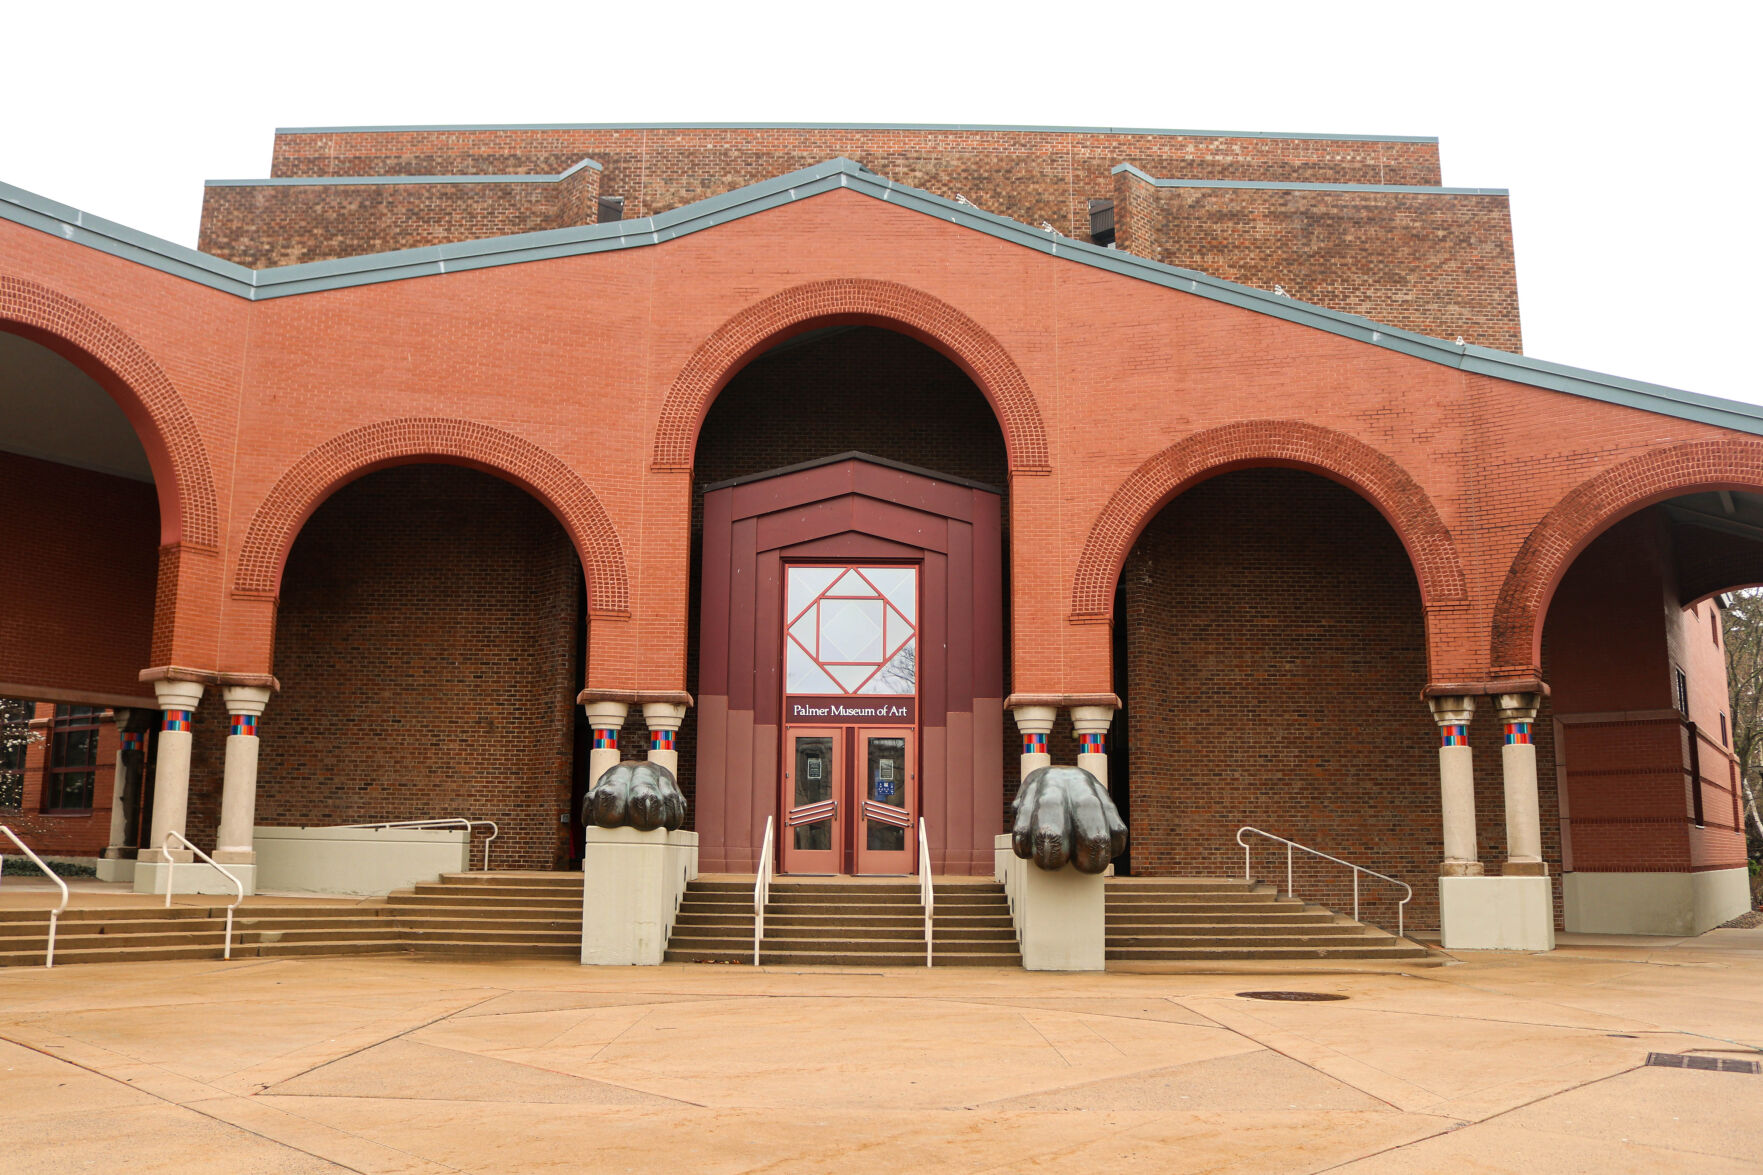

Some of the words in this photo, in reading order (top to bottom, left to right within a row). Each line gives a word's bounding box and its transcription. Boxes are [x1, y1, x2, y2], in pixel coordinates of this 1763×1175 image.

[794, 705, 829, 716] Palmer
[831, 705, 875, 716] Museum
[877, 705, 888, 716] of
[889, 706, 907, 716] Art
